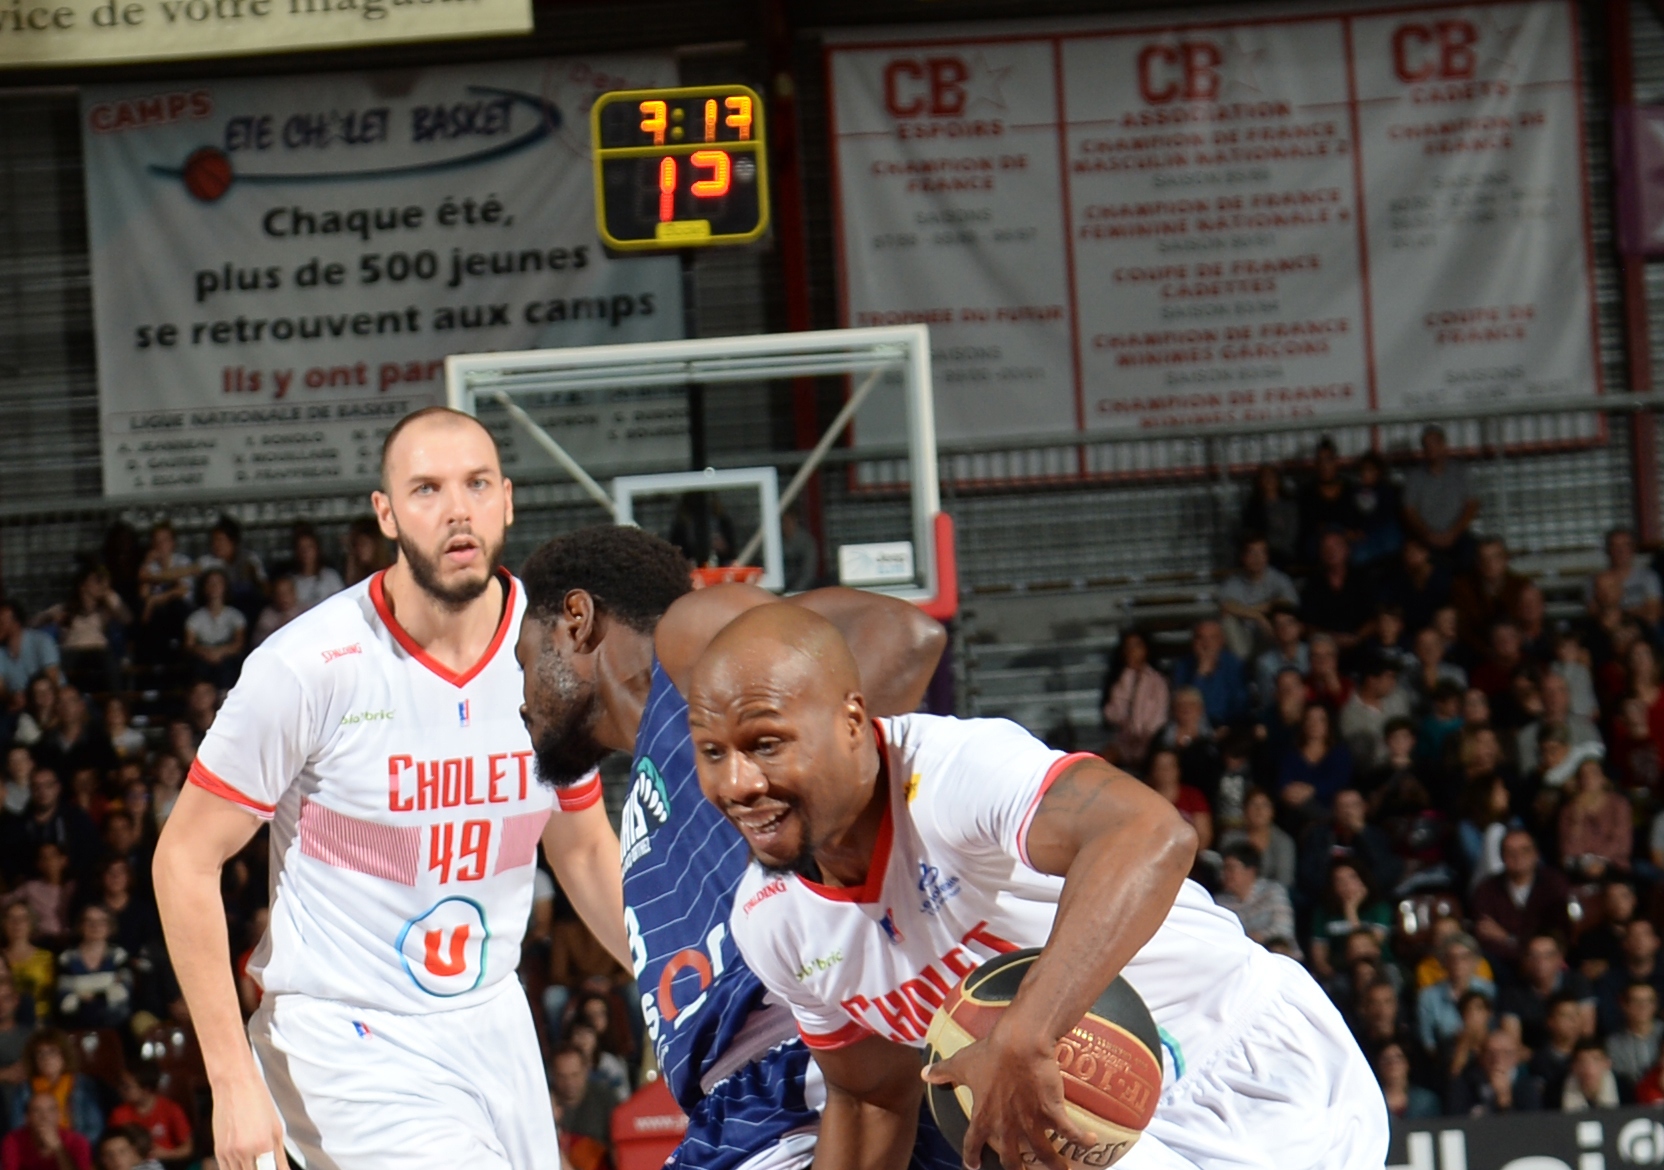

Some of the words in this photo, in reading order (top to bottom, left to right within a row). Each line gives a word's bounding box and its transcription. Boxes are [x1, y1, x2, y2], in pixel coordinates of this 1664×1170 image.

[92, 0, 144, 27] de
[1136, 38, 1224, 105] CB
[1391, 19, 1478, 84] CB
[883, 57, 970, 118] CB
[90, 91, 212, 133] CAMPS
[411, 98, 514, 142] BASKET
[1119, 101, 1292, 128] ASSOCIATION
[1081, 133, 1203, 153] CHAMPION
[1213, 129, 1240, 145] DE
[1245, 121, 1337, 141] FRANCE
[263, 205, 424, 241] Chaque
[437, 193, 514, 227] été,
[1084, 199, 1210, 219] CHAMPION
[1216, 195, 1244, 211] DE
[1251, 187, 1341, 207] FRANCE
[194, 262, 282, 302] plus
[295, 257, 345, 287] de
[360, 250, 438, 284] 500
[449, 244, 590, 288] jeunes
[1194, 261, 1224, 278] DE
[1231, 253, 1321, 274] FRANCE
[136, 322, 179, 348] se
[191, 306, 420, 345] retrouvent
[434, 302, 511, 331] aux
[524, 291, 655, 327] camps
[1091, 331, 1219, 349] CHAMPION
[1223, 325, 1253, 341] DE
[1258, 317, 1350, 337] FRANCE
[222, 365, 262, 392] Ils
[274, 368, 293, 398] y
[305, 362, 367, 389] ont
[1096, 394, 1221, 414] CHAMPION
[1227, 389, 1257, 405] DE
[1263, 382, 1355, 403] FRANCE
[129, 412, 185, 430] LIGUE
[190, 405, 302, 427] NATIONALE
[307, 404, 332, 420] DE
[336, 400, 408, 418] BASKET
[388, 749, 533, 812] CHOLET
[428, 819, 492, 886] 49
[424, 924, 471, 977] U
